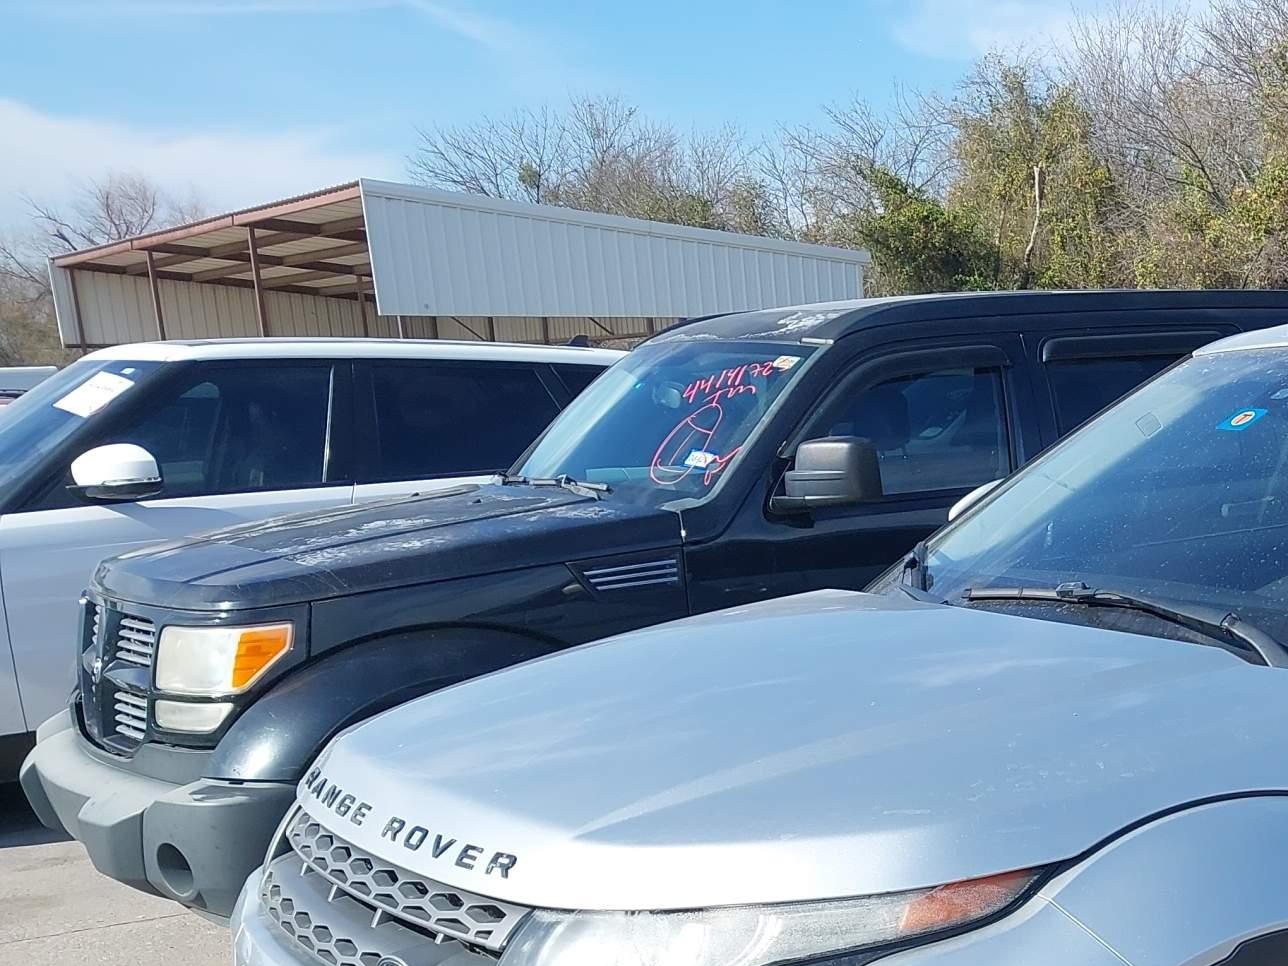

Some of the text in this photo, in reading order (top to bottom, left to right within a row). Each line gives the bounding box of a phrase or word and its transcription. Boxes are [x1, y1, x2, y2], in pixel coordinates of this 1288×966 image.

[682, 361, 788, 404] 4414172
[304, 766, 518, 880] RANGE ROVER
